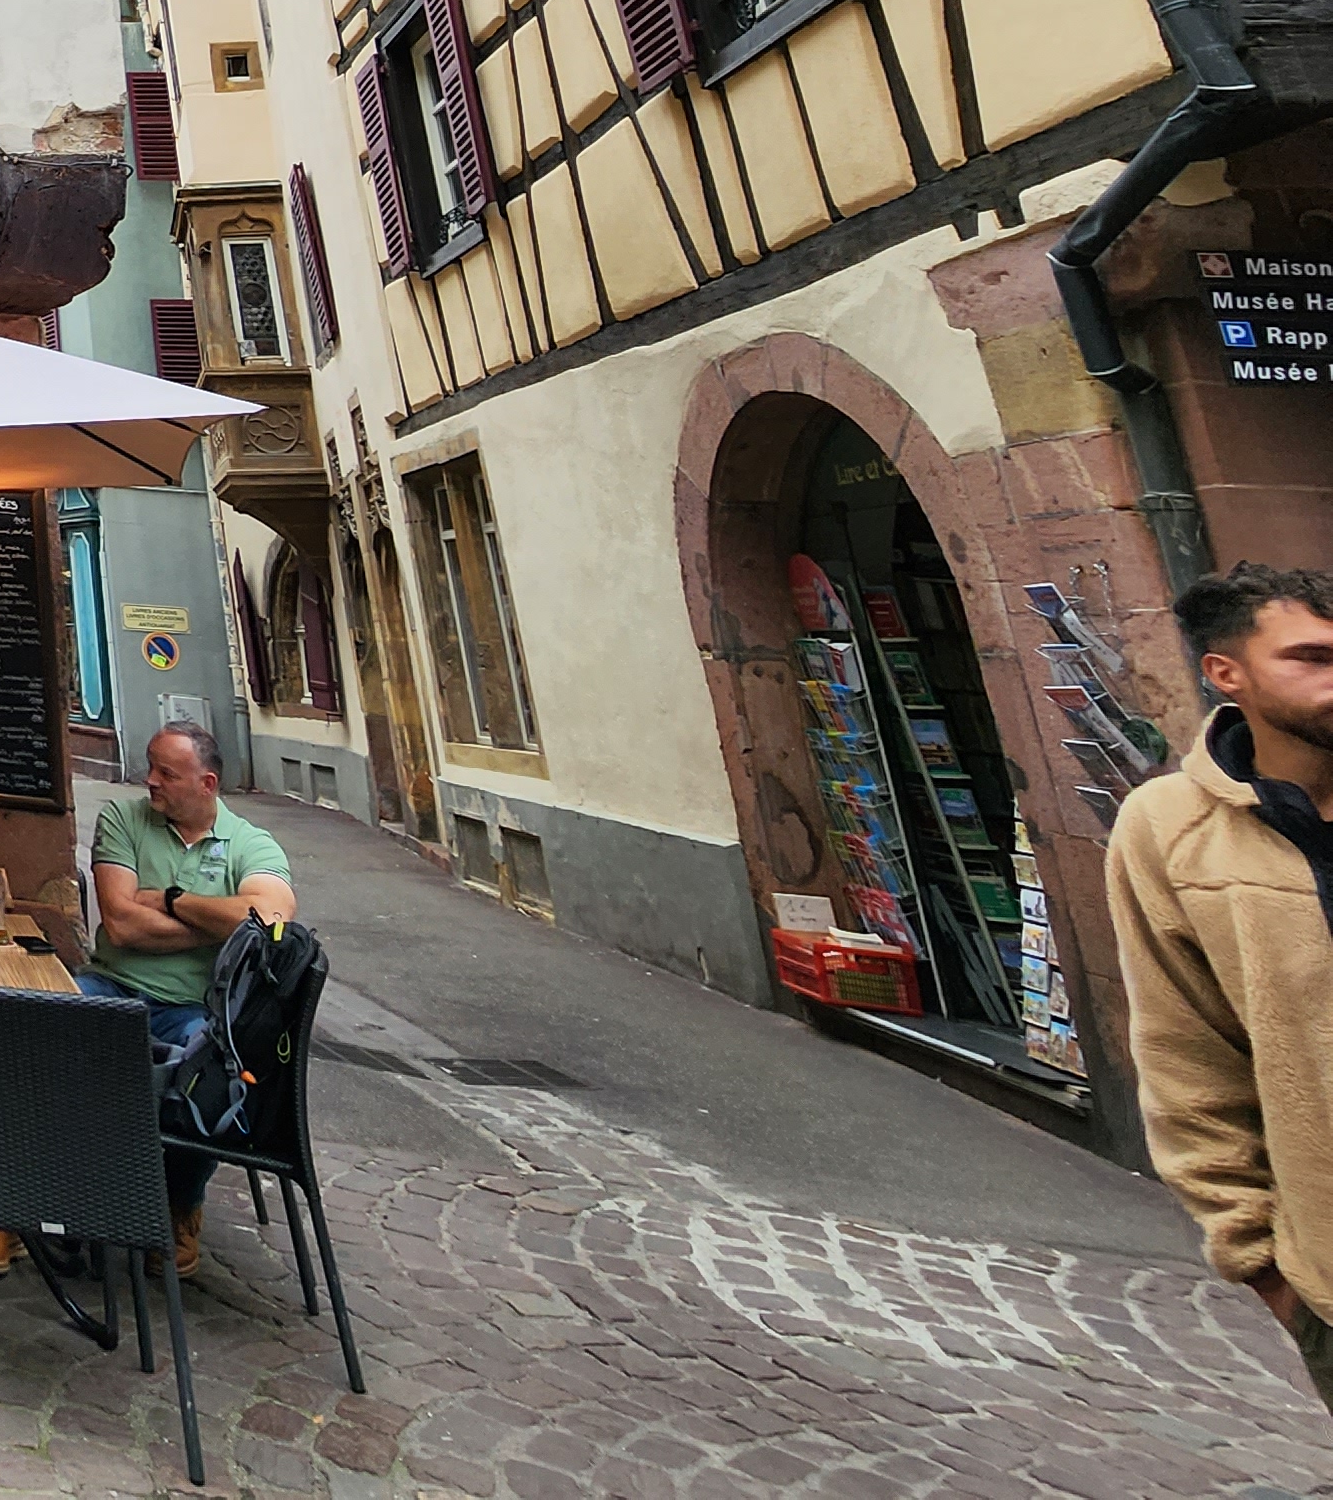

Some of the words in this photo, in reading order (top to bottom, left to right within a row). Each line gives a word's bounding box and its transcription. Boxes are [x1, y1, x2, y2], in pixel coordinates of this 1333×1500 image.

[1245, 257, 1333, 276] Maison
[1212, 291, 1294, 310] Musée
[1305, 292, 1333, 311] Ha
[1266, 326, 1328, 350] Rapp
[1233, 360, 1318, 381] Musée
